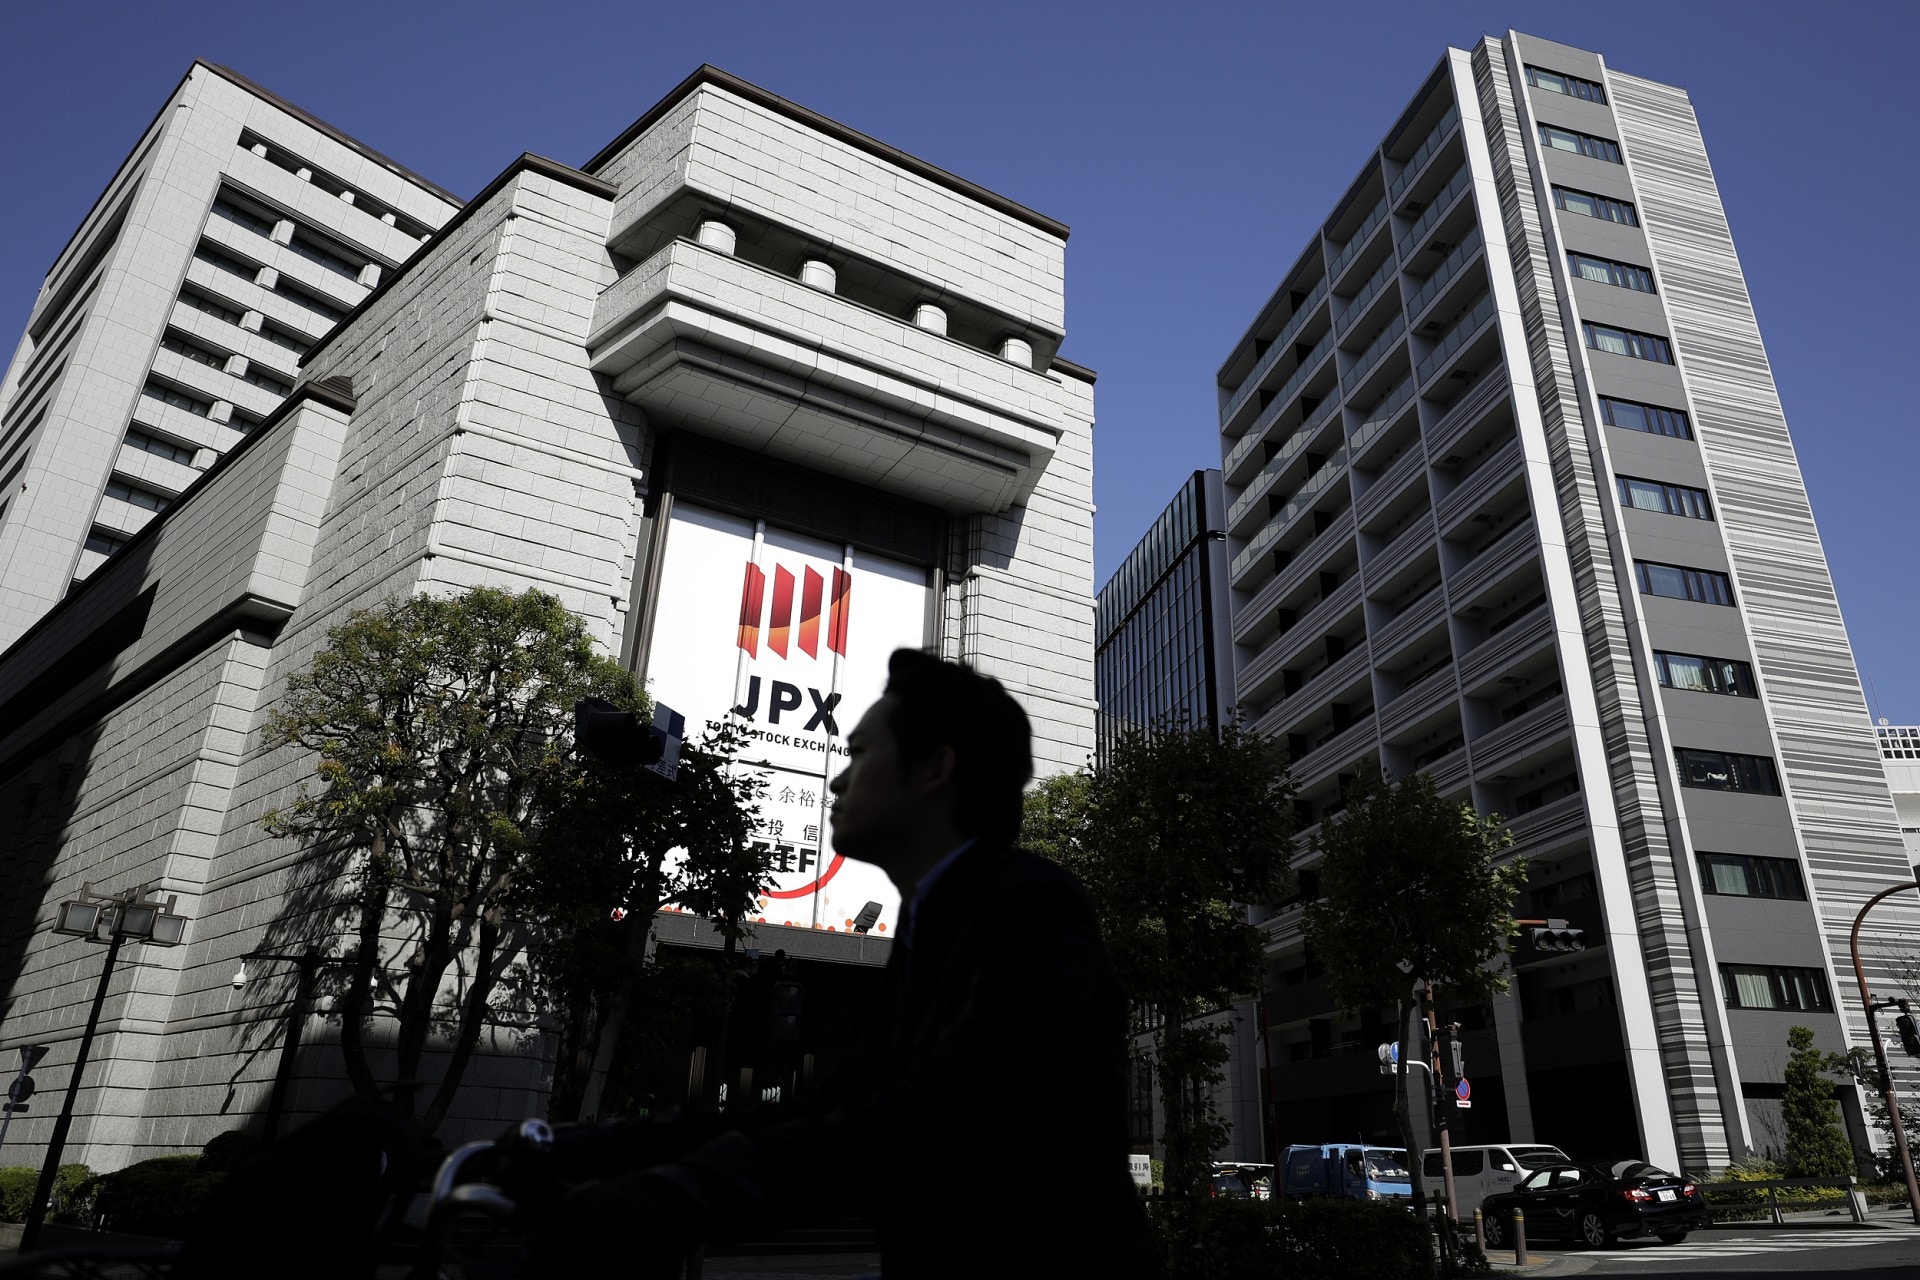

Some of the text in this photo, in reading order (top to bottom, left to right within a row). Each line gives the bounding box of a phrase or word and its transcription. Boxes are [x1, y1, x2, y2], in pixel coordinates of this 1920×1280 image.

[736, 676, 842, 736] JPX
[750, 731, 790, 747] STOCK
[793, 737, 849, 757] EXCHANG
